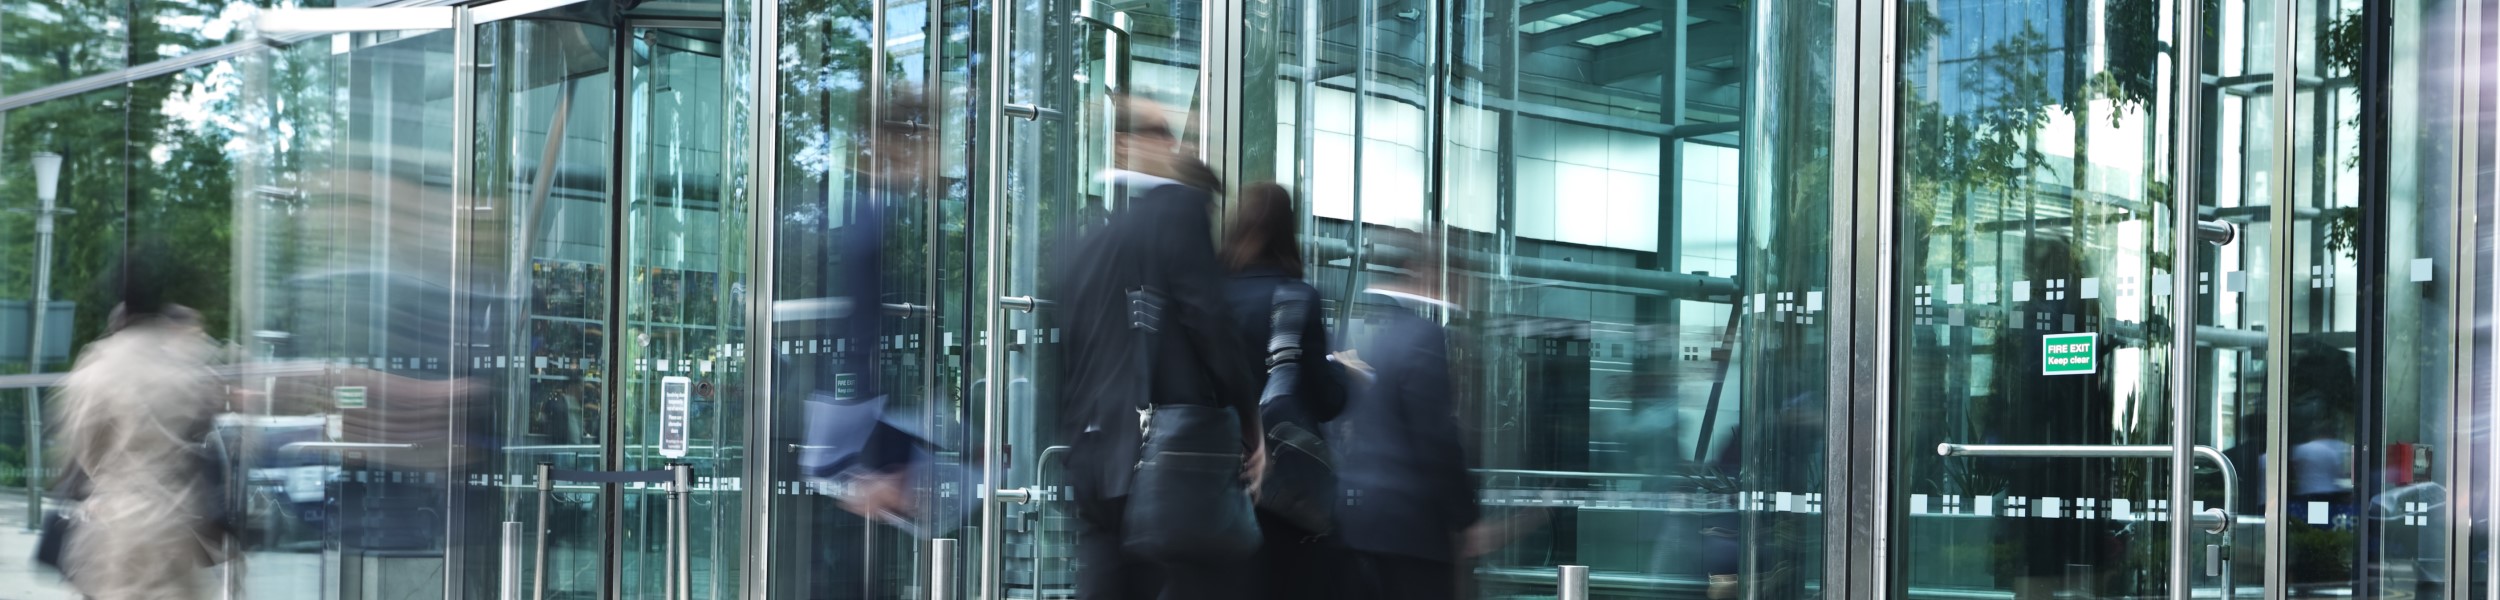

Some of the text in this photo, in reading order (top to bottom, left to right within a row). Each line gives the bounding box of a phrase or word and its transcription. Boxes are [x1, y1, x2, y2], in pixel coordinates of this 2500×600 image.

[2048, 343, 2090, 354] FIRE EXIT
[2048, 356, 2090, 366] Keep clear
